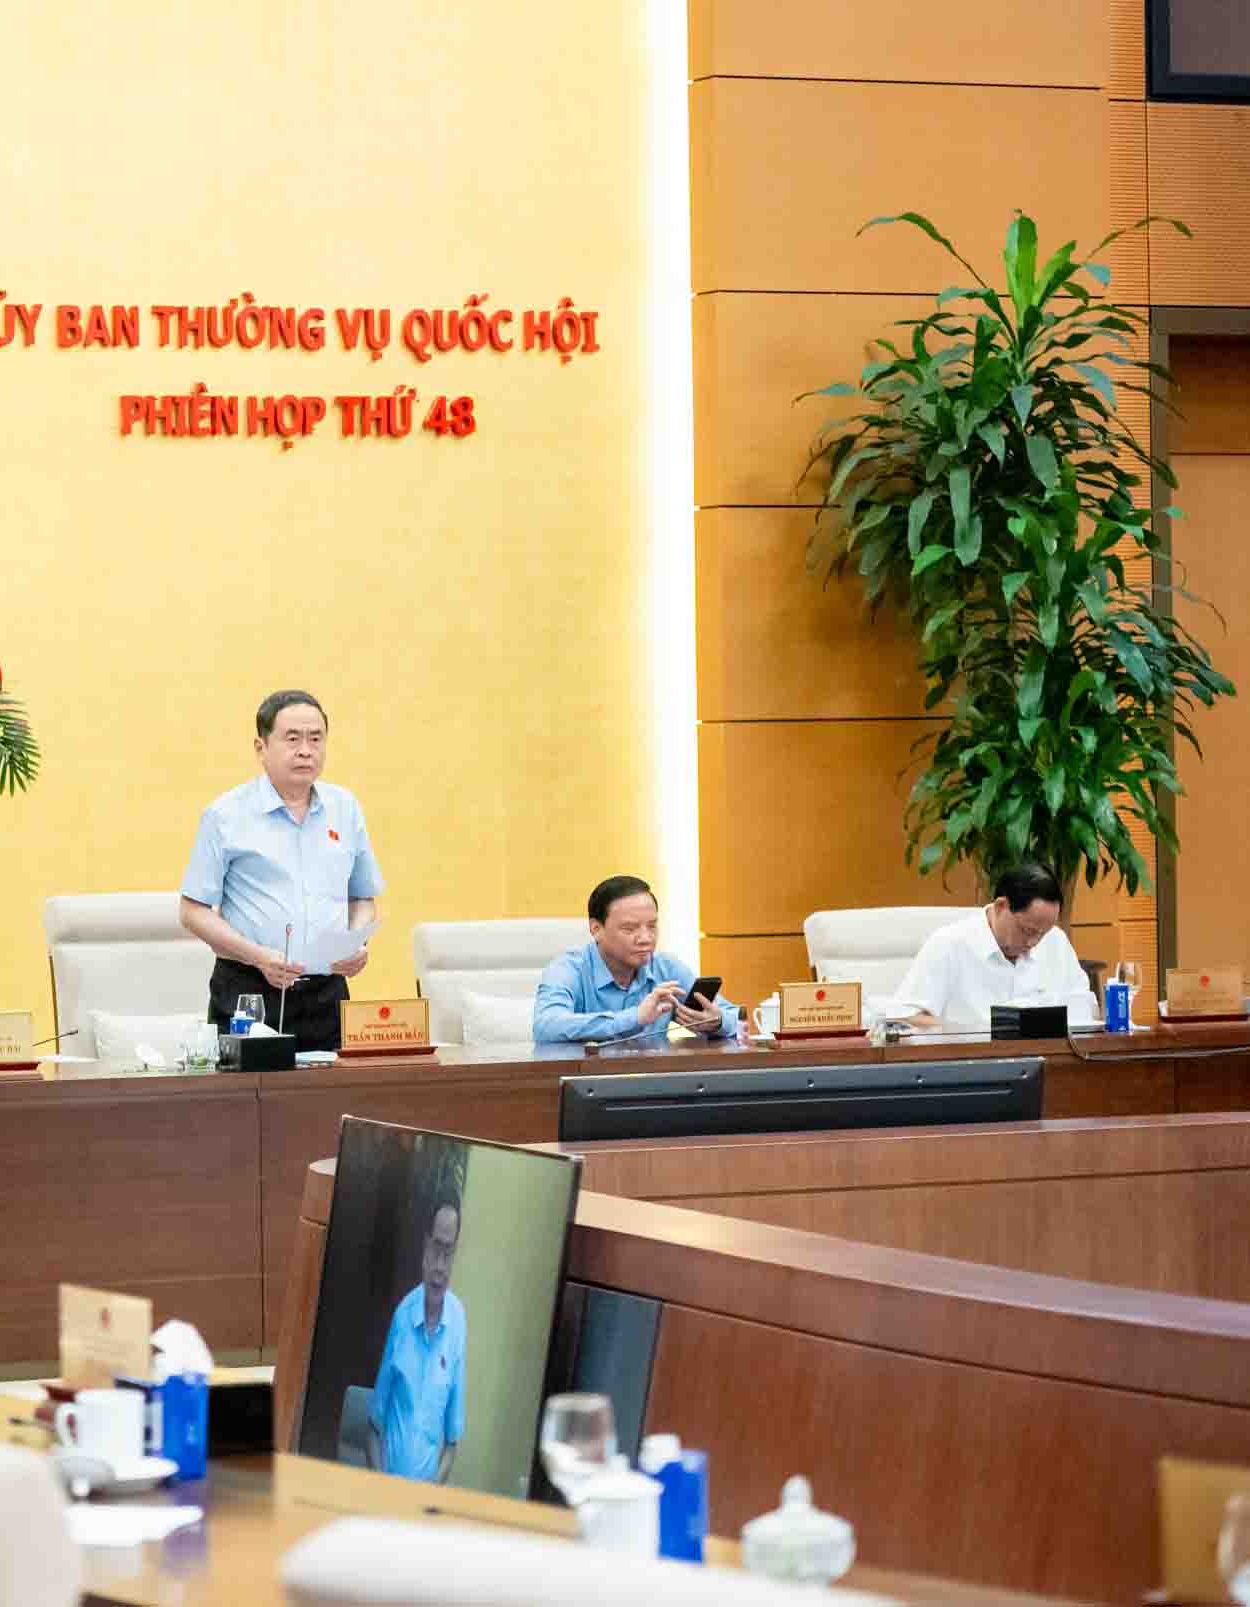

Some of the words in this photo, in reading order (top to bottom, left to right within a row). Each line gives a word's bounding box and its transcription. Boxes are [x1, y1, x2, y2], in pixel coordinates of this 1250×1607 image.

[55, 305, 140, 350] BAN
[151, 292, 326, 353] THƯỜNG
[335, 308, 391, 361] VỤ
[401, 293, 514, 364] QUỐC
[523, 297, 600, 365] HỘI
[119, 382, 239, 438] PHIÊN
[246, 394, 327, 450] HỌP
[333, 385, 417, 440] THỨ
[422, 395, 477, 439] 48
[373, 1030, 403, 1041] THANH
